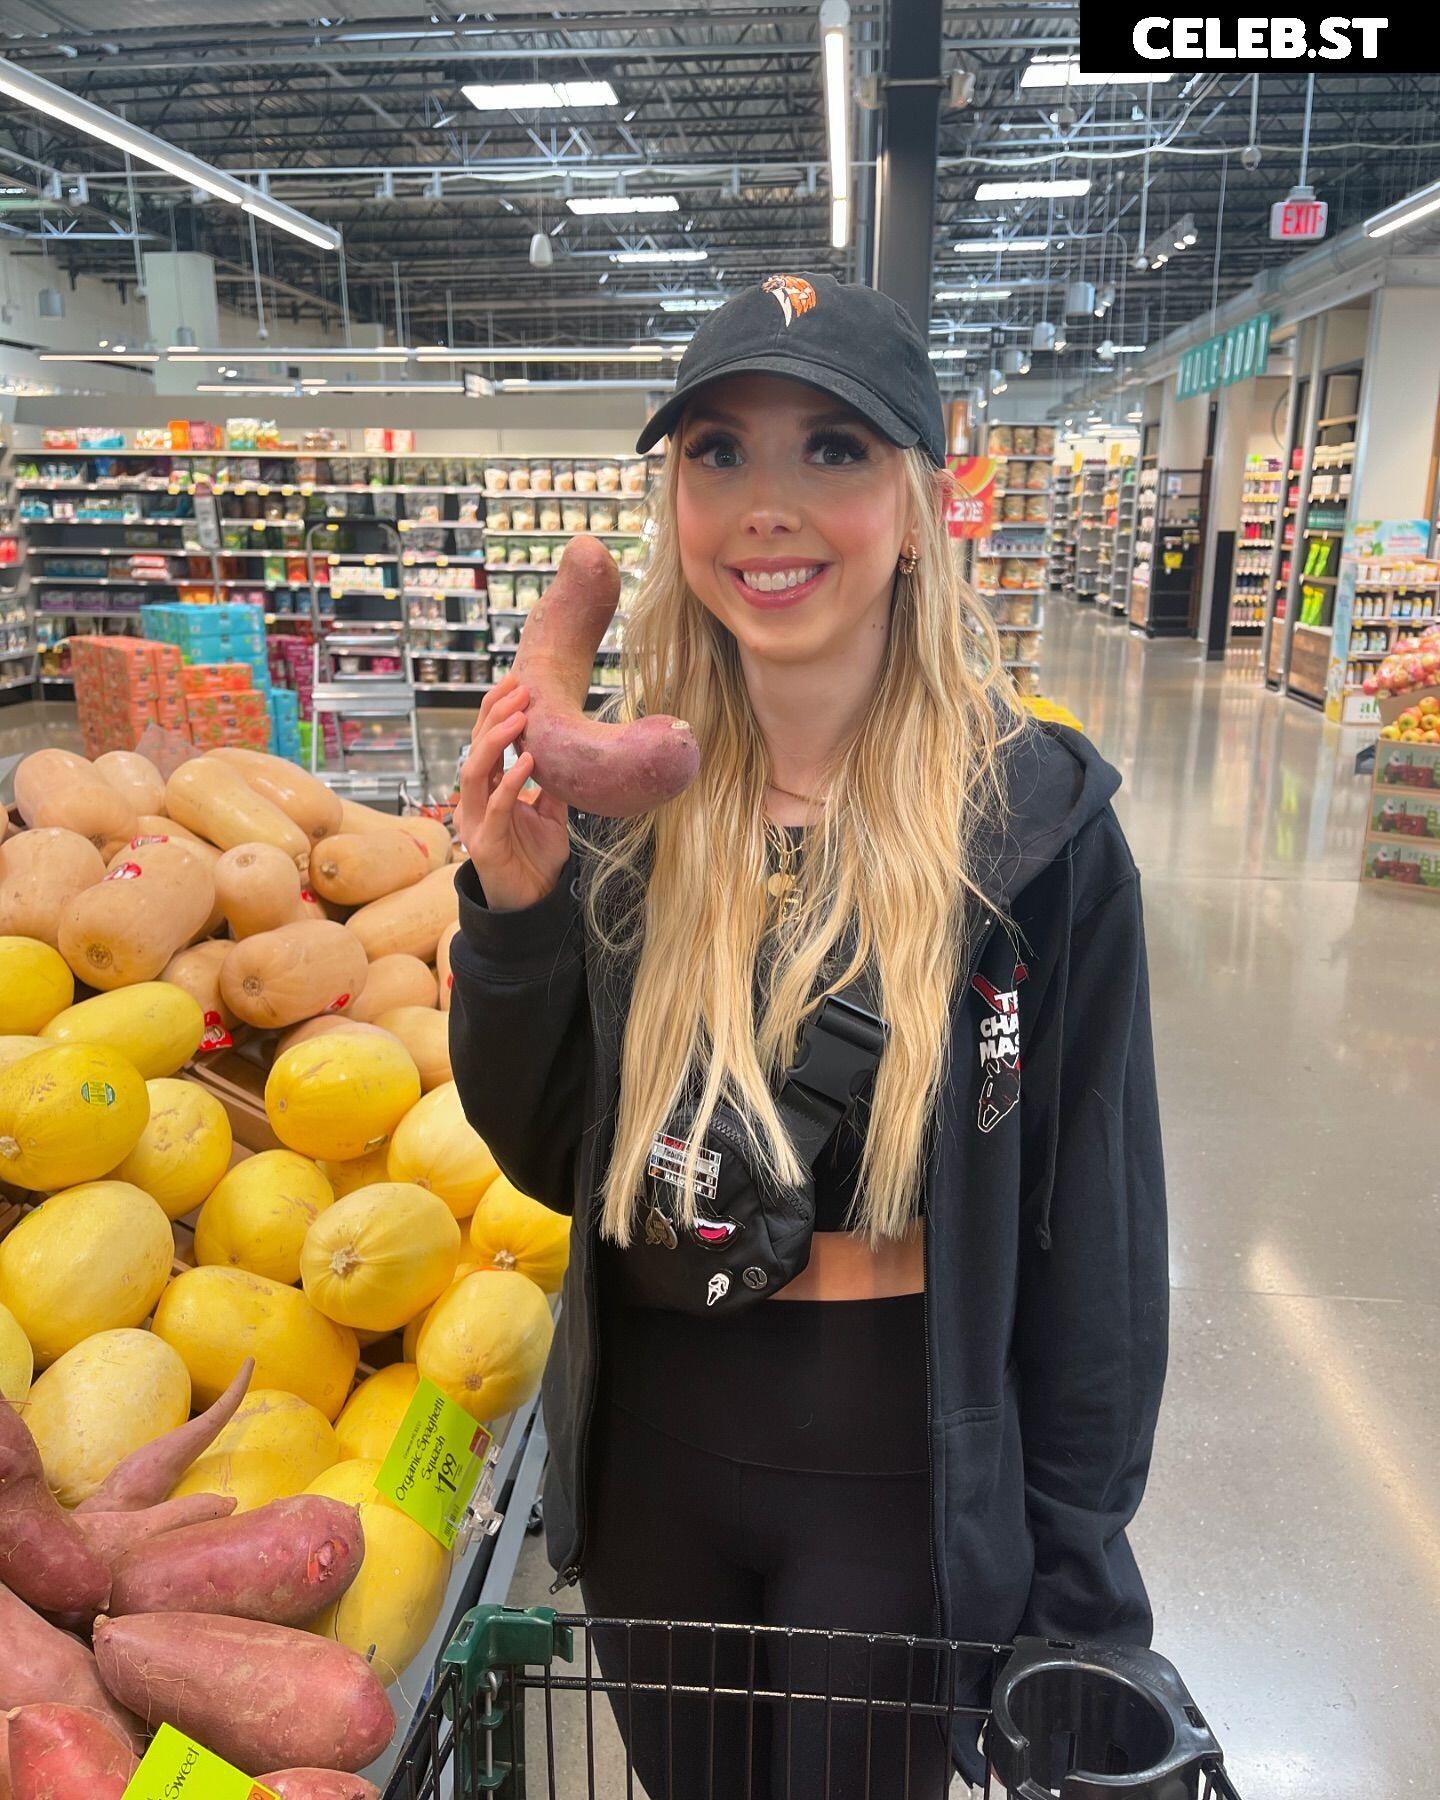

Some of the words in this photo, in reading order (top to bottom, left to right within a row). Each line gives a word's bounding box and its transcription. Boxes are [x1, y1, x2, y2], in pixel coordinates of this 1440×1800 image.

[1281, 204, 1321, 235] EXIT
[395, 1450, 423, 1501] Organic
[416, 1396, 445, 1451] Spaghetti
[421, 1435, 446, 1480] Squash
[164, 1746, 200, 1800] Sweet
